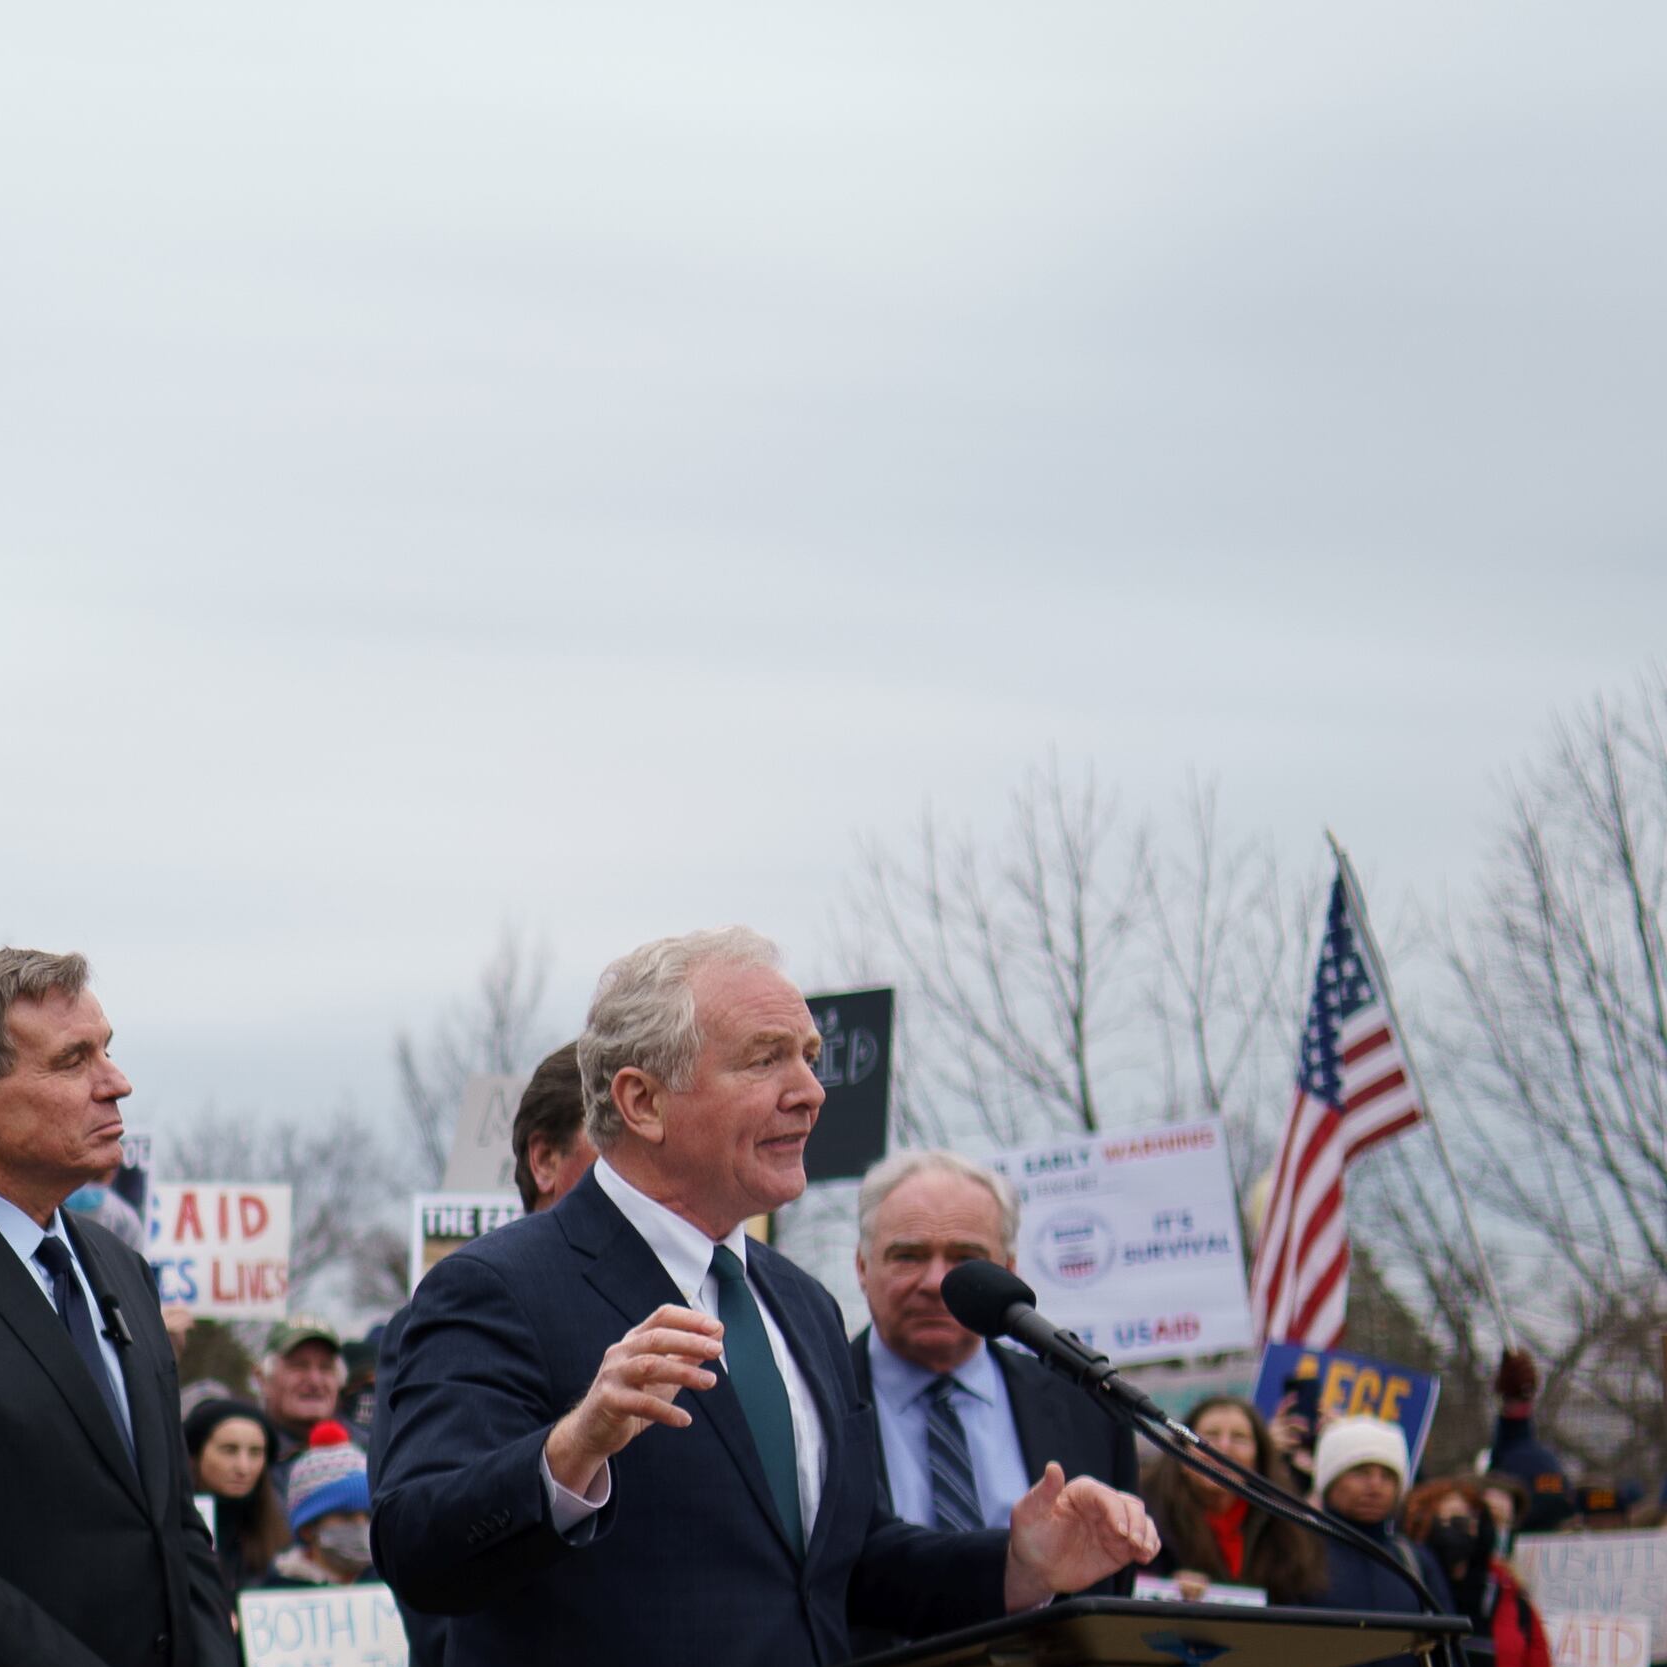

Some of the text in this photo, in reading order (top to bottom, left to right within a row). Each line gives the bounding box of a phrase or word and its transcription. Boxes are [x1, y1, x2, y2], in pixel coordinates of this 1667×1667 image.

[1103, 1127, 1216, 1165] WARNING
[150, 1189, 270, 1246] AID
[211, 1256, 289, 1306] LIVES
[248, 1597, 356, 1657] BOTH
